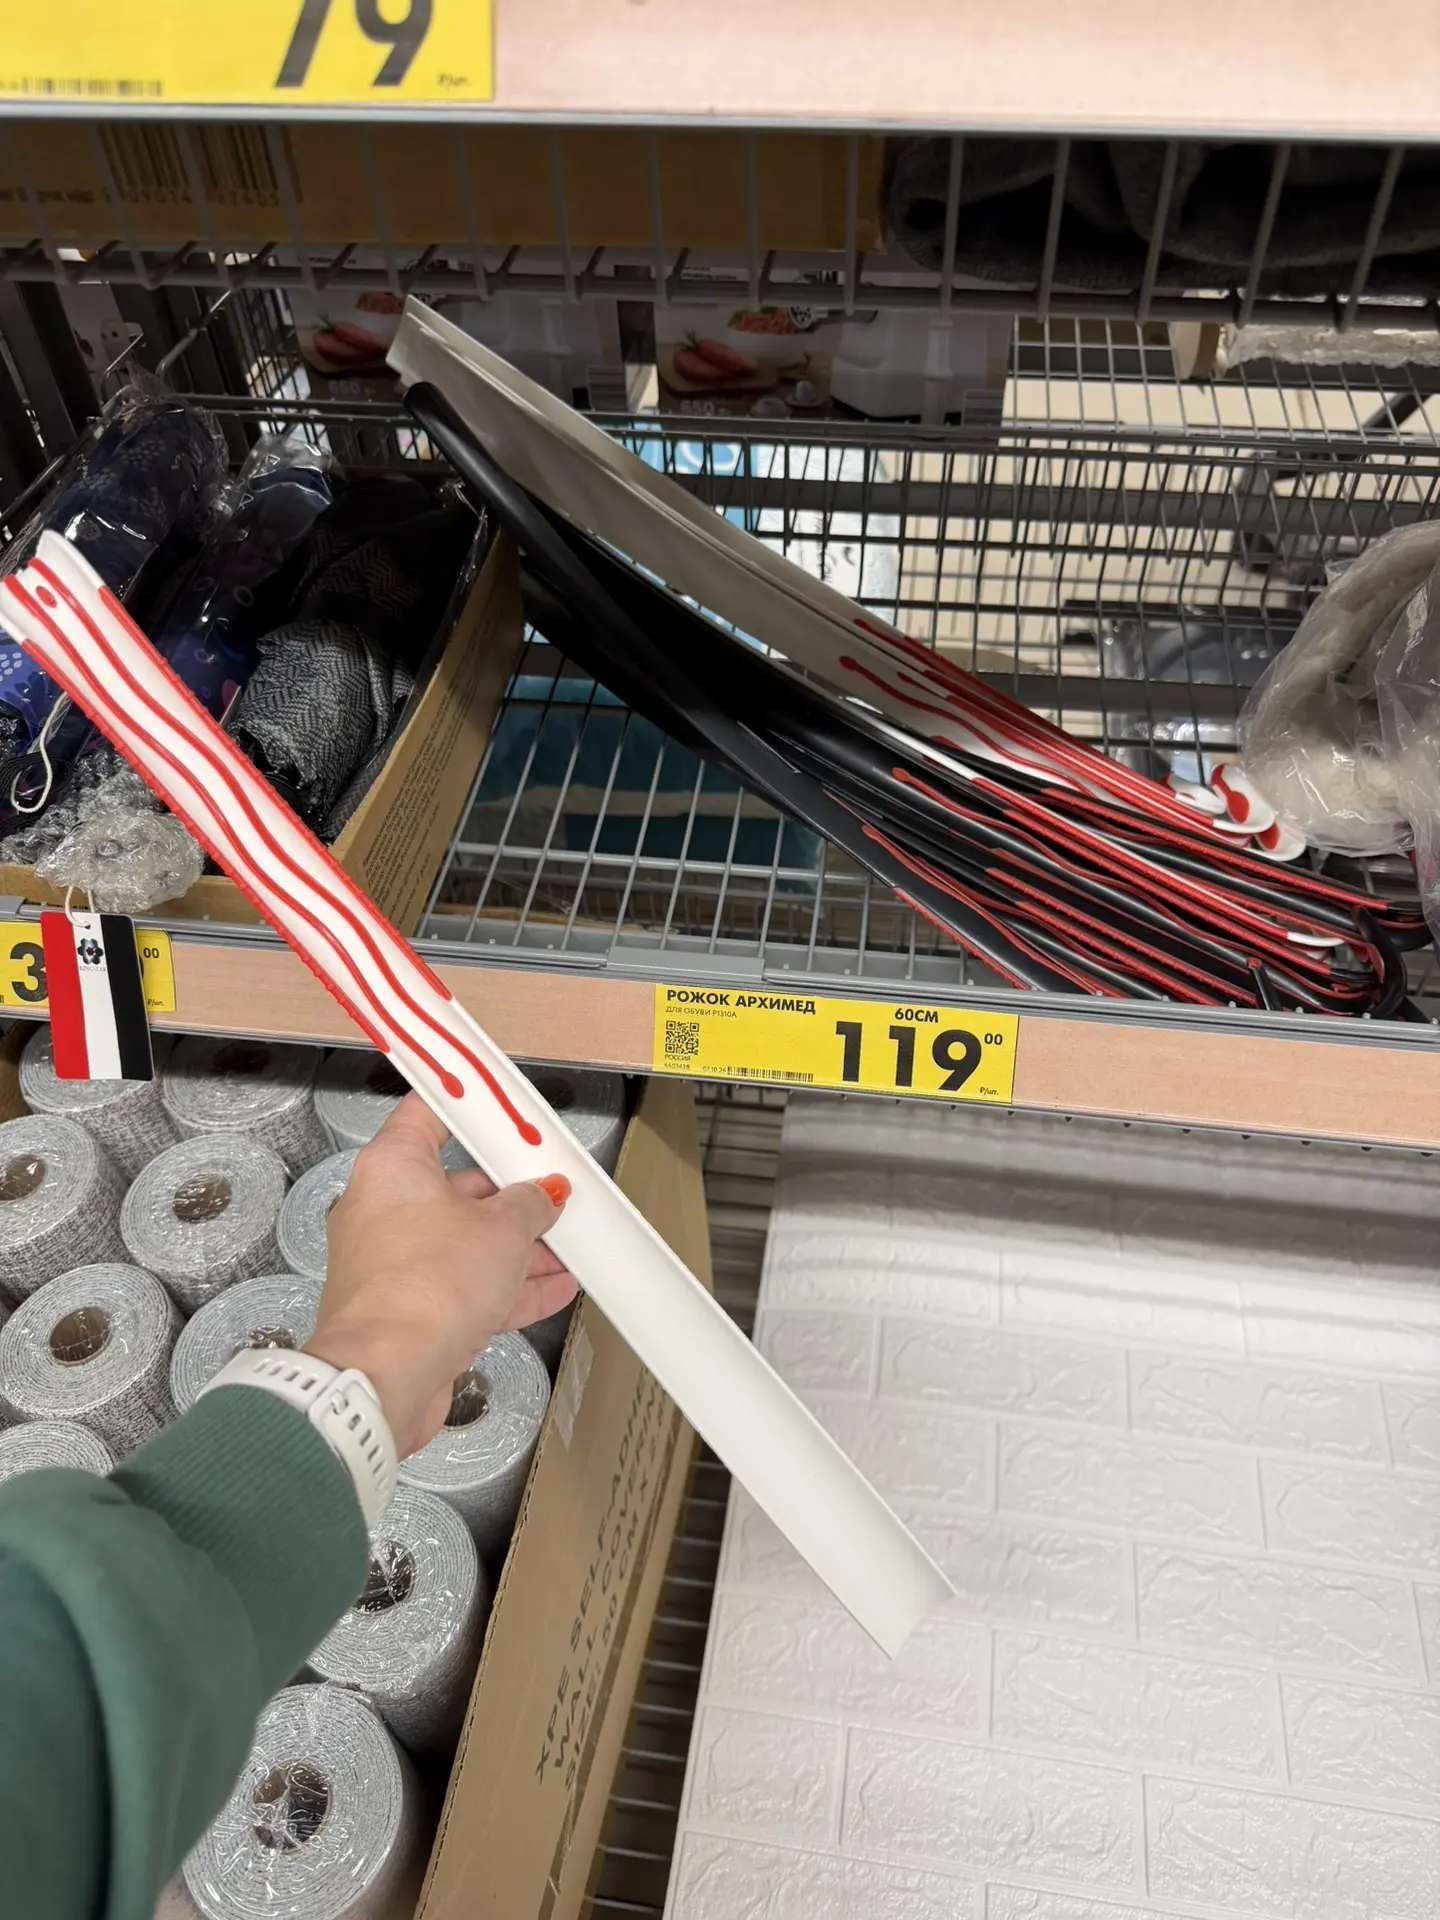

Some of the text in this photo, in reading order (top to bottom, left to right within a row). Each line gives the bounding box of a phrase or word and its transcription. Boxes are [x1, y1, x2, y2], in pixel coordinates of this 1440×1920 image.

[274, 0, 433, 88] 79
[143, 947, 160, 959] 00
[666, 989, 939, 1023] РОЖОК АРХИМЕД 60СМ
[683, 1007, 712, 1016] ОБУВИ
[664, 1054, 691, 1062] РОССИЯ
[835, 1021, 1003, 1091] 119 00
[554, 1377, 659, 1768] WALL COVERIN
[619, 1508, 639, 1581] CM
[535, 1663, 571, 1786] XPE
